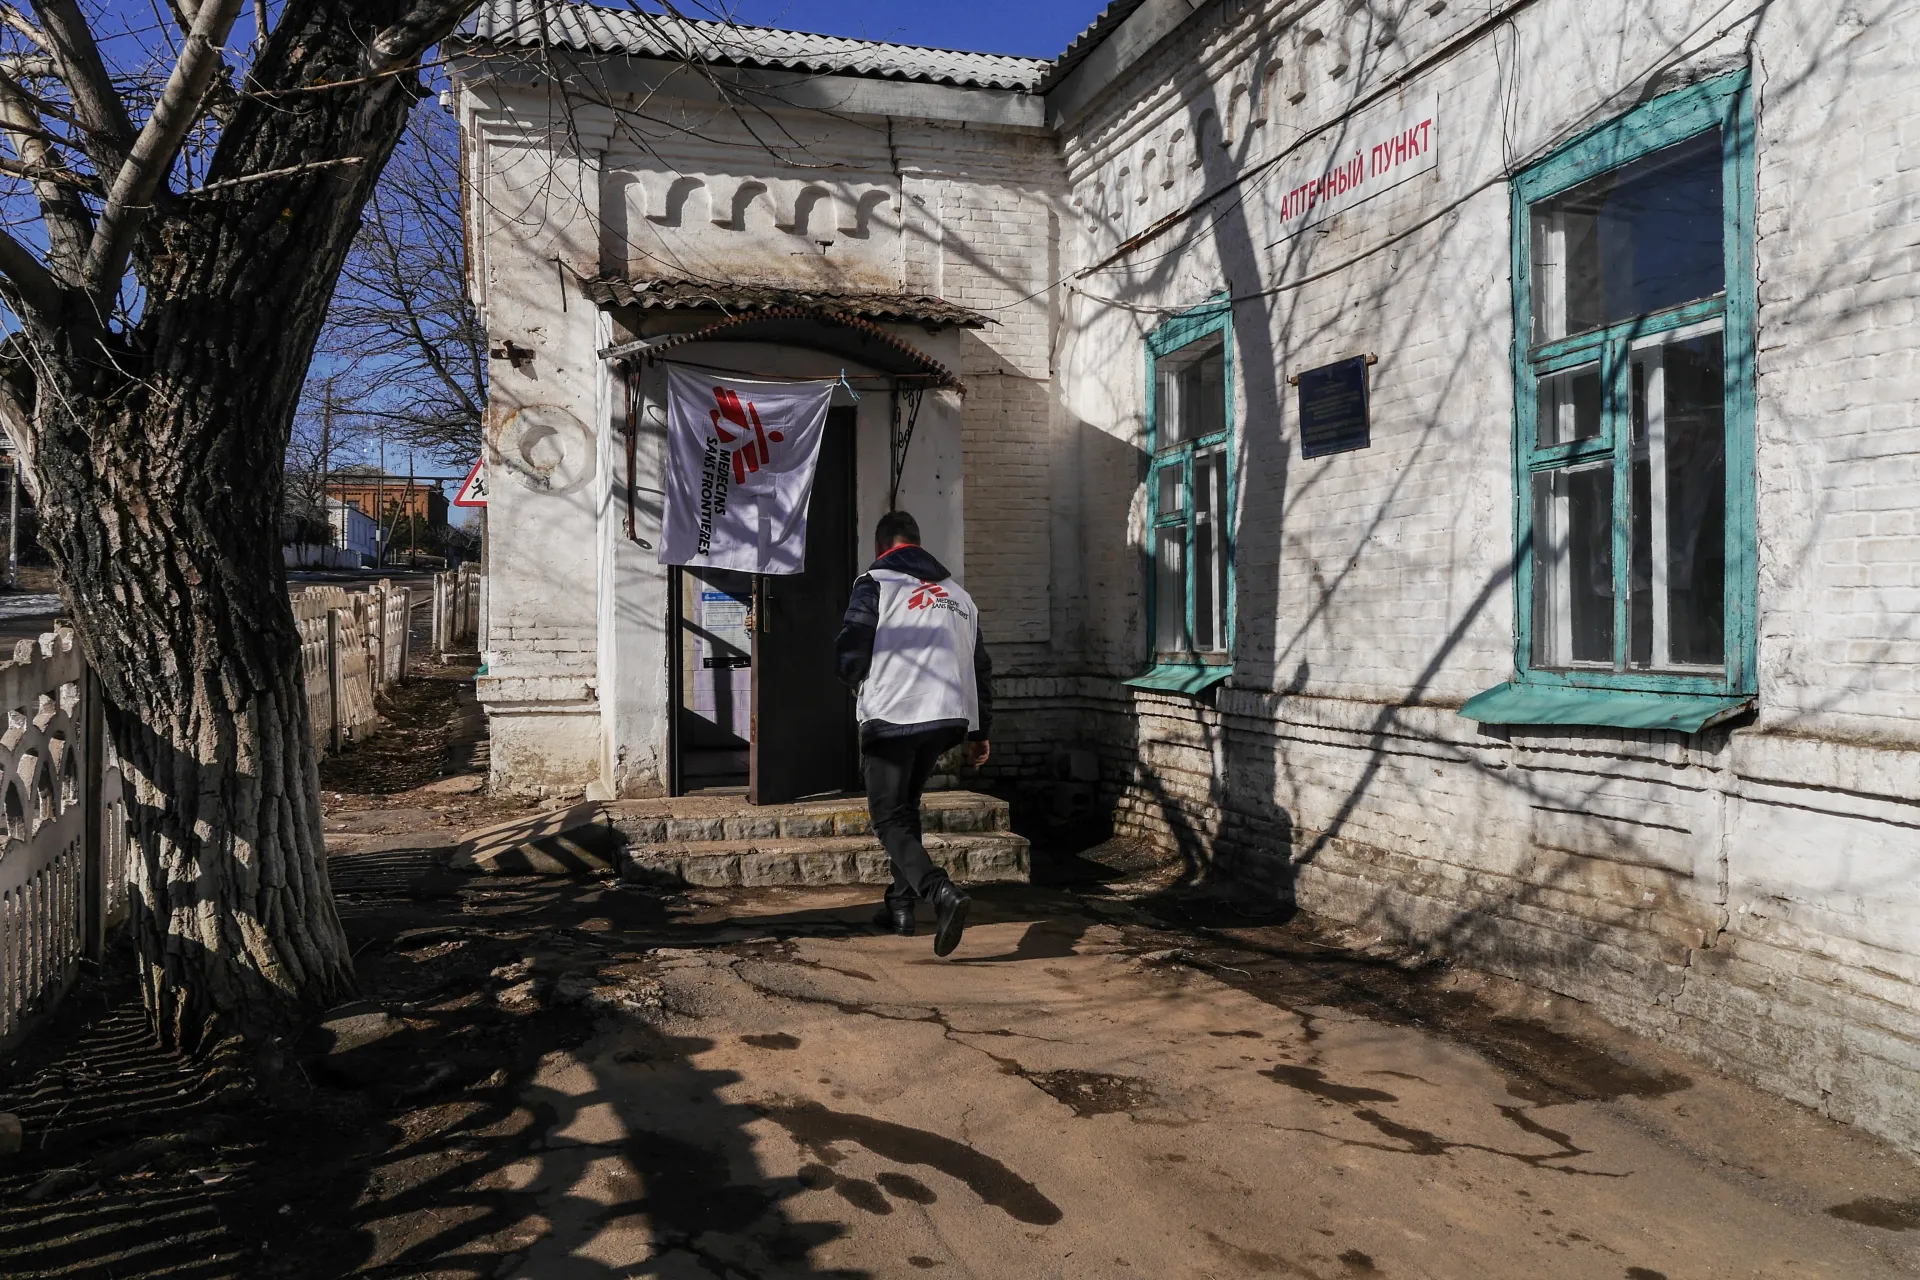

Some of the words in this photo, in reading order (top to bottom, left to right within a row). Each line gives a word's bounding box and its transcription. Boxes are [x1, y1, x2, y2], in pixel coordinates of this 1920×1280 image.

[1279, 149, 1364, 224] АПТЕЧНЫЙ
[1371, 118, 1432, 178] ПУНКТ
[703, 436, 718, 470] SANS
[715, 449, 731, 515] MEDECINS
[697, 471, 714, 557] FRONTIERES
